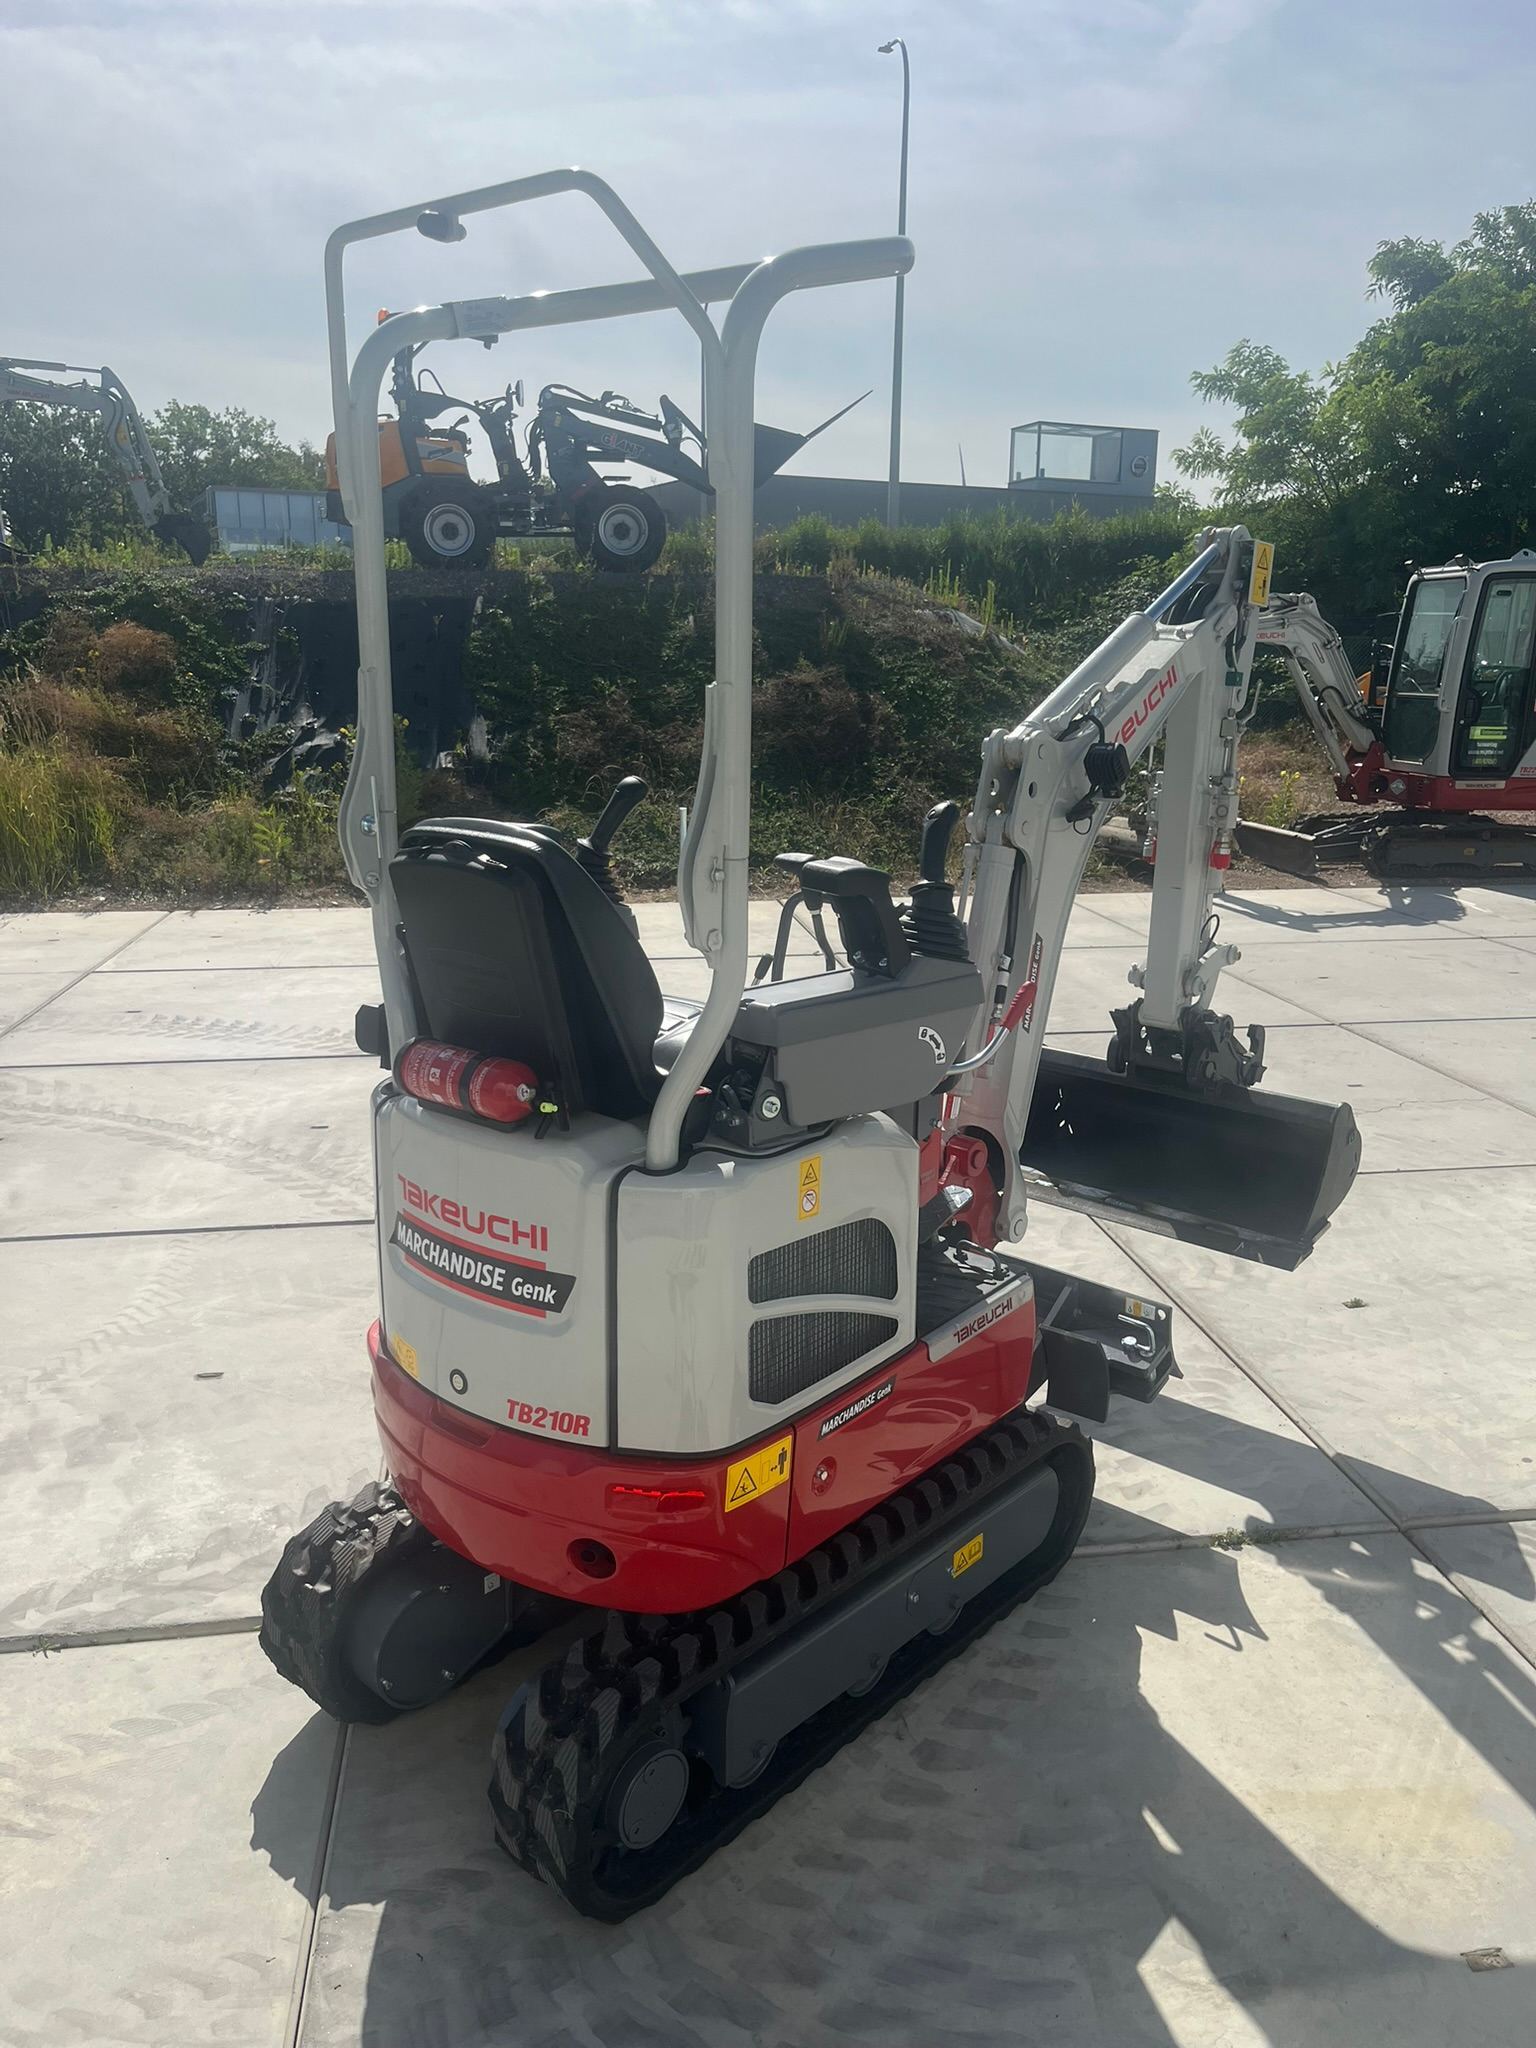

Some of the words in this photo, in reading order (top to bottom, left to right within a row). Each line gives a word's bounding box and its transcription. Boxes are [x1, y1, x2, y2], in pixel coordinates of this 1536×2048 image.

[398, 1173, 548, 1252] TAKEUCHI
[397, 1221, 506, 1291] MARCHANDISE
[511, 1277, 558, 1305] Genk
[507, 1398, 591, 1436] TB210R
[820, 1391, 877, 1437] MARCHANDISE
[876, 1383, 893, 1400] Genk
